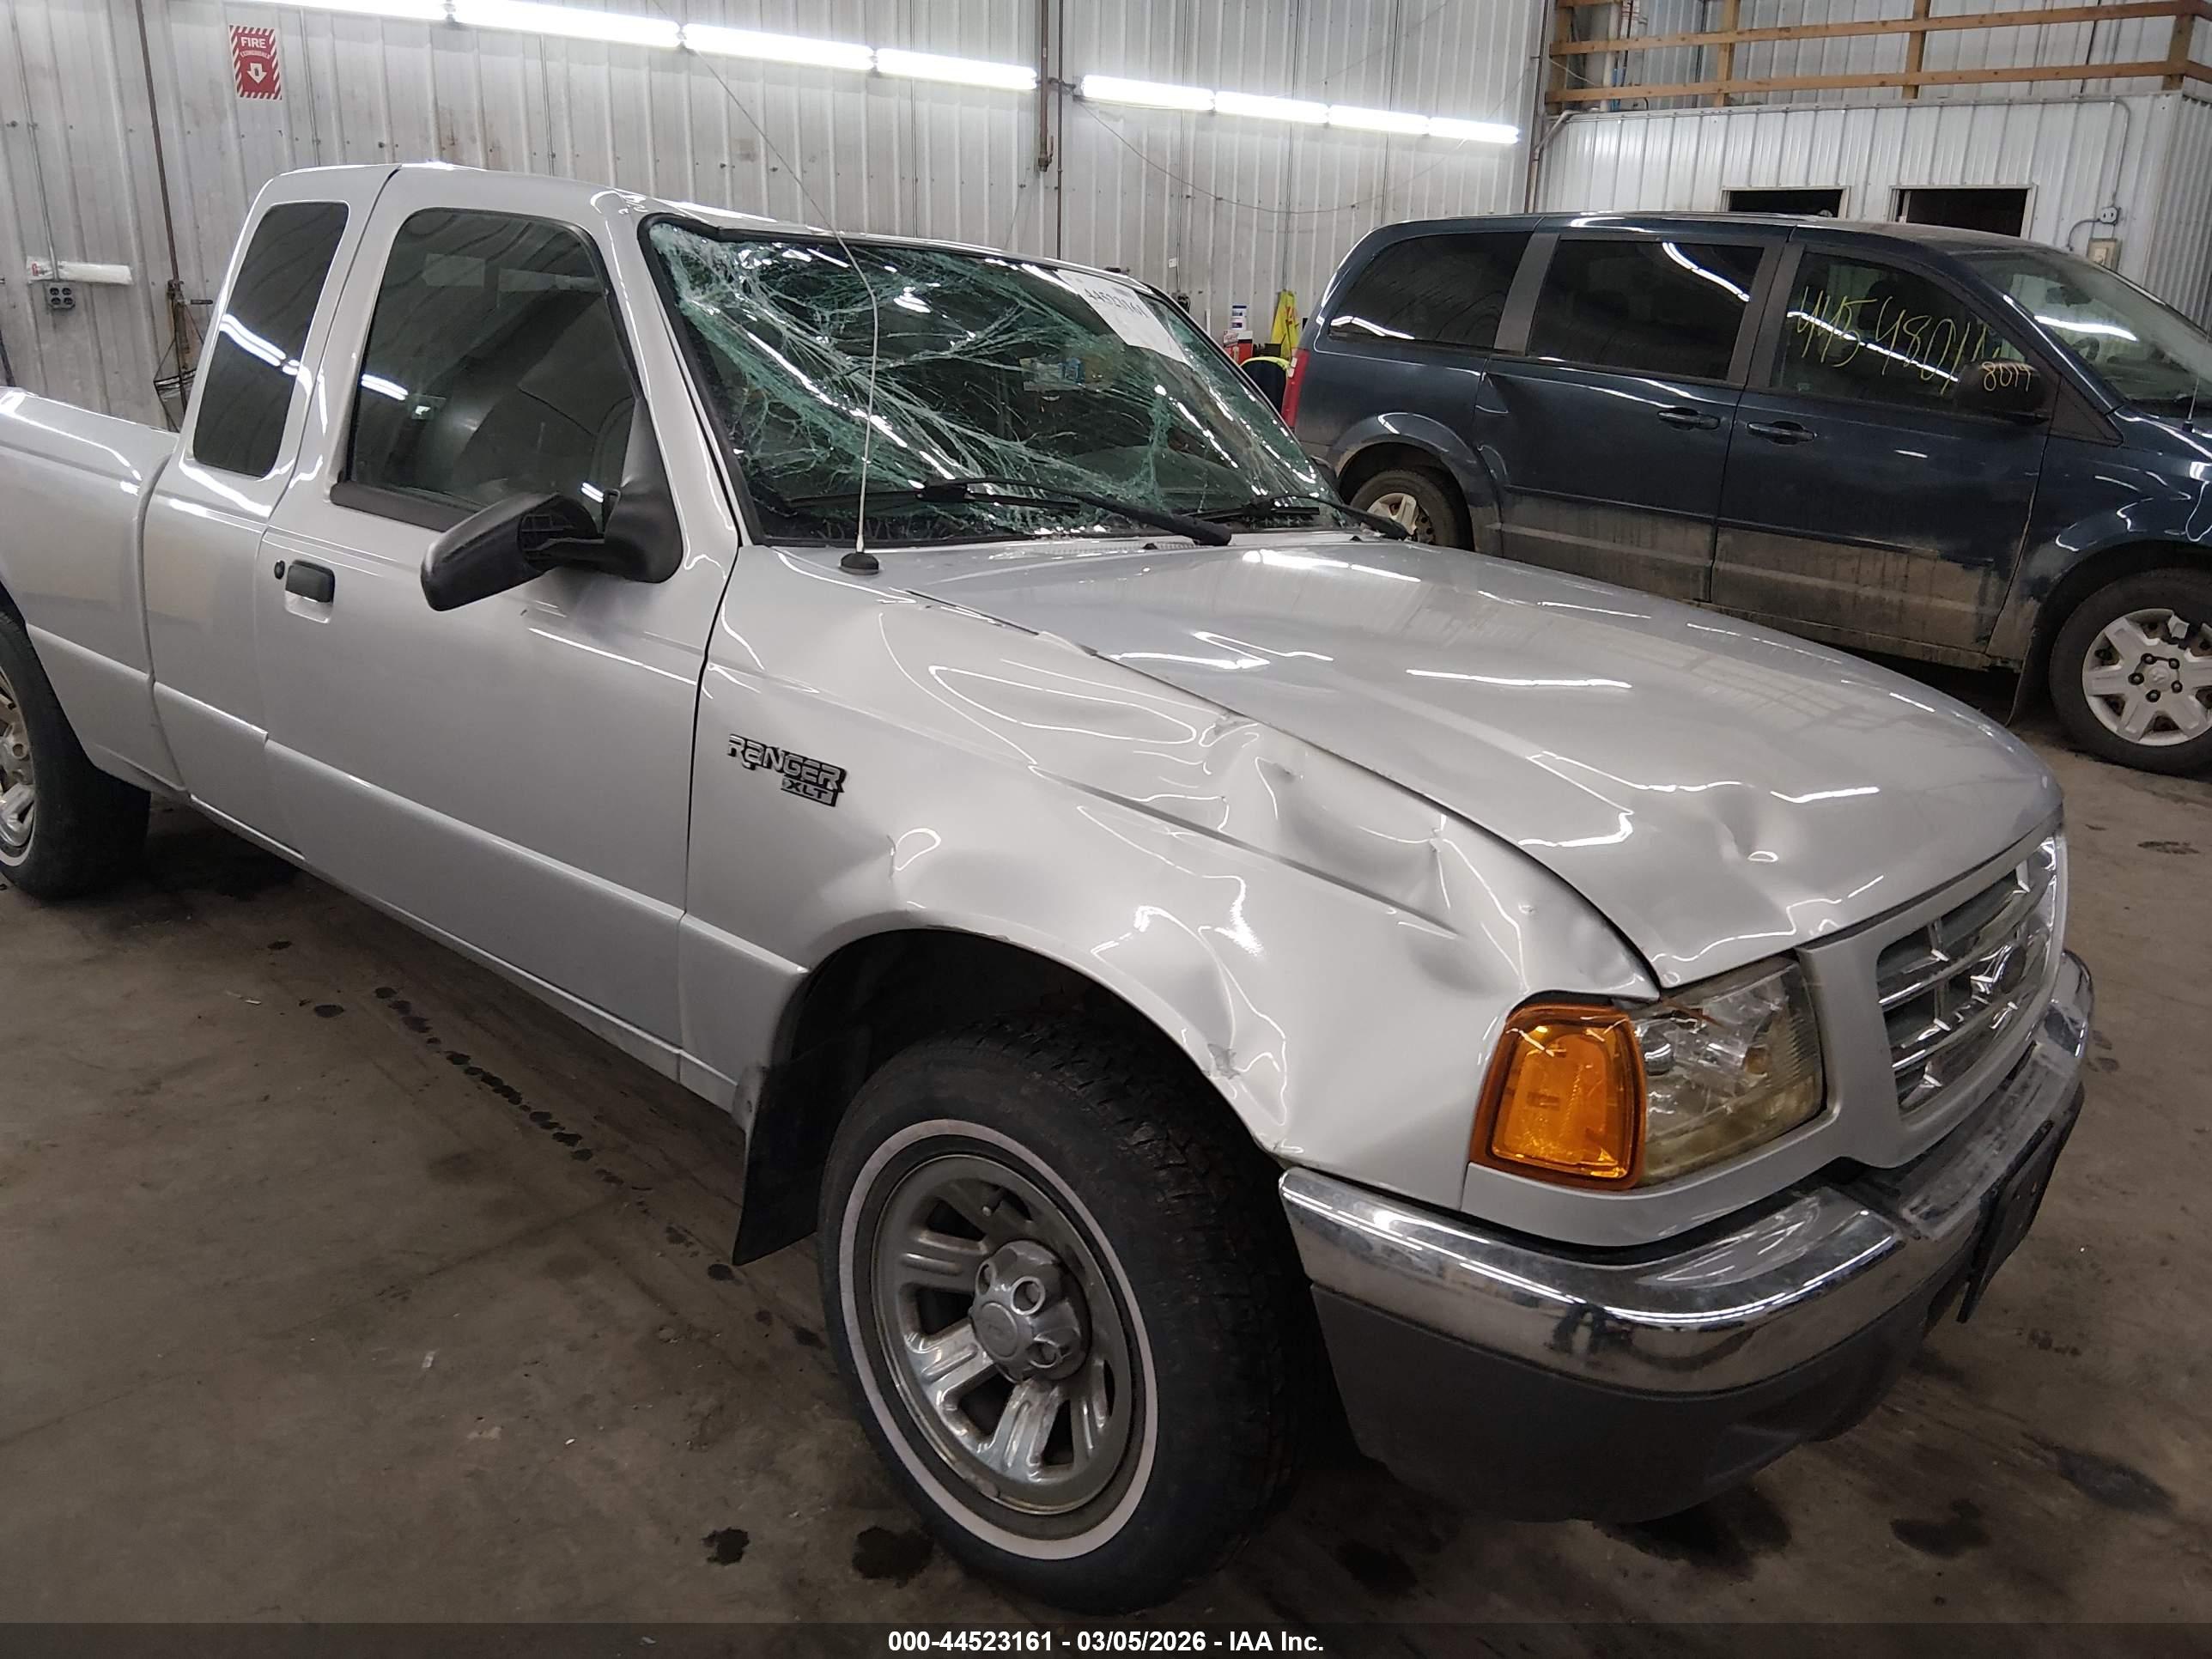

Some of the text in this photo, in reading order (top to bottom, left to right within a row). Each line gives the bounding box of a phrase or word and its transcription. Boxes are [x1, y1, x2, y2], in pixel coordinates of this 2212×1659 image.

[240, 36, 267, 49] FIRE
[1981, 361, 2032, 392] 8014
[727, 733, 847, 793] RANGER
[786, 778, 830, 800] XLT
